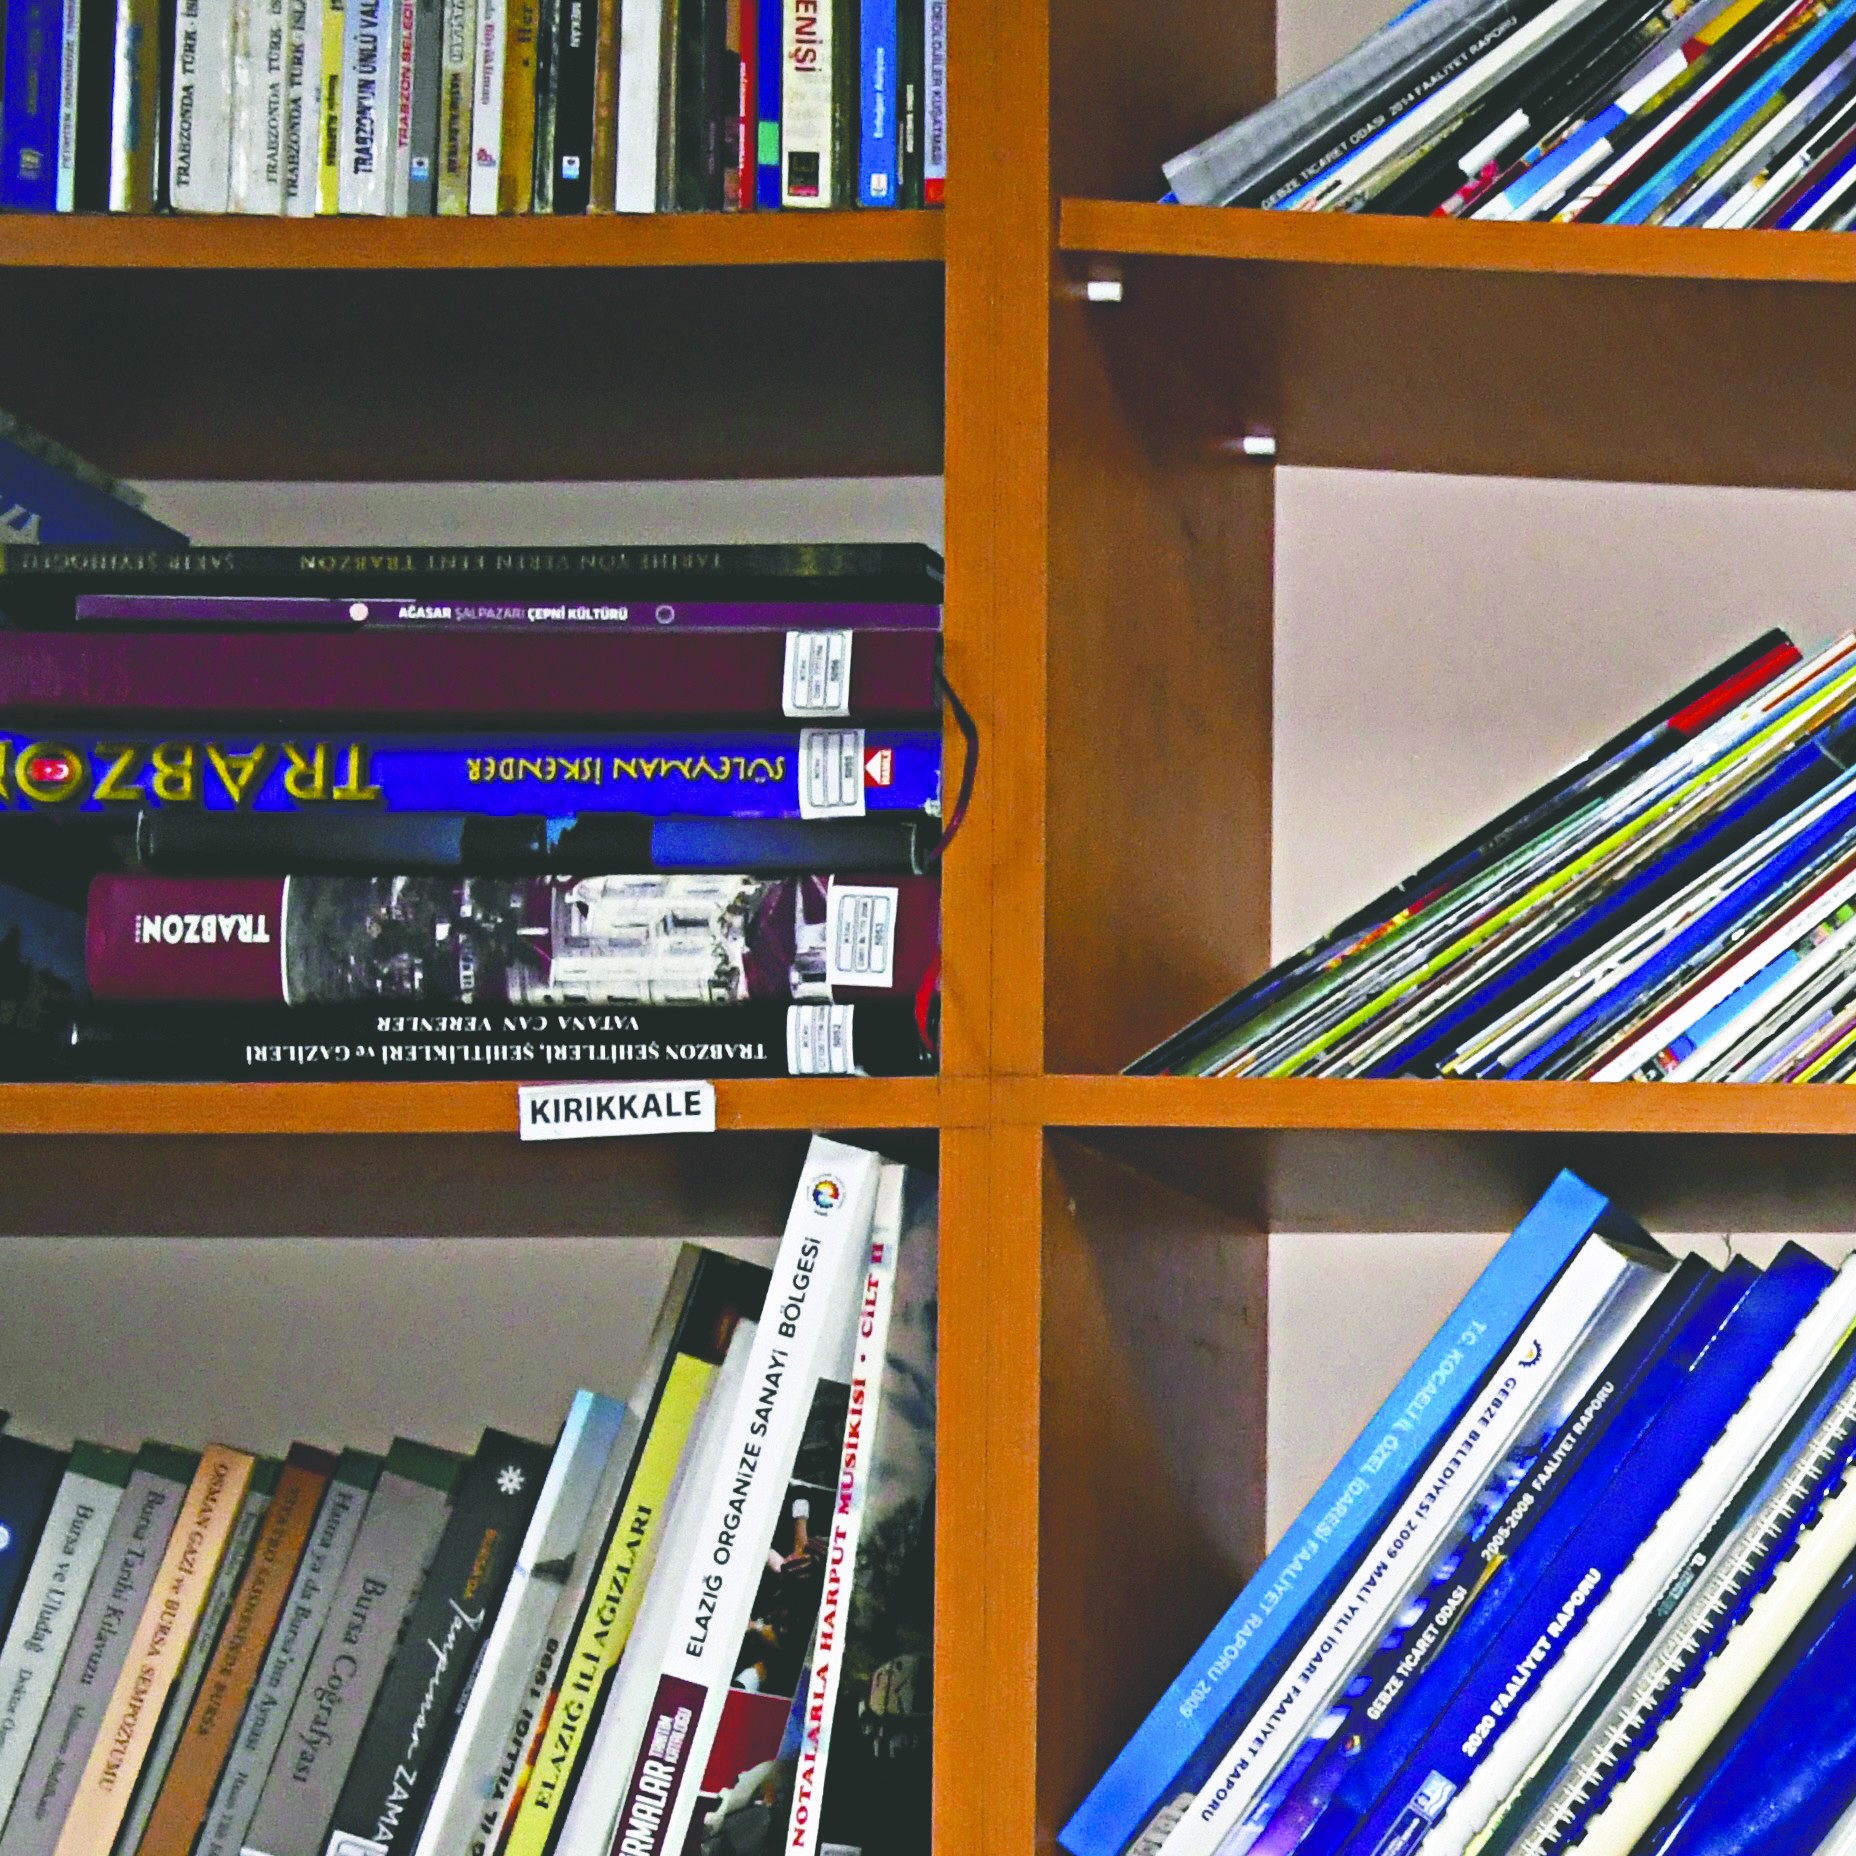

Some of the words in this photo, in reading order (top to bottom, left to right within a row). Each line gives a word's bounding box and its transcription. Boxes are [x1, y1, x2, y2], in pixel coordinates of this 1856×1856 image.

[466, 756, 601, 784] İSKENDER
[612, 756, 785, 784] SÜLEYMAN
[142, 914, 269, 943] TRABZON
[376, 1015, 490, 1030] VERENLER
[503, 1015, 547, 1030] CAN
[558, 1015, 638, 1030] VATANA
[530, 1090, 700, 1124] KIRIKKALE
[1473, 1373, 1520, 1430] GEBZE
[682, 1571, 725, 1658] ELAZIĞ
[708, 1440, 762, 1567] ORGANİZE
[745, 1347, 789, 1437] SANAYİ
[773, 1234, 821, 1339] BÖLGESİ
[1410, 1427, 1482, 1520] BELEDİYESİ
[1382, 1517, 1420, 1561] 2009
[1352, 1558, 1391, 1604] MALİ
[341, 1575, 388, 1649] Bursa
[1330, 1601, 1361, 1636] YILI
[529, 1698, 585, 1809] ELAZIĞ
[570, 1650, 602, 1693] İLİ
[587, 1503, 654, 1647] AĞIZLARI
[1295, 1633, 1339, 1686] İDARE
[1458, 1712, 1497, 1757] 2020
[1487, 1633, 1554, 1717] FAALİYET
[1544, 1566, 1603, 1639] RAPORU
[284, 1649, 361, 1786] Coğrafyası
[1243, 1684, 1304, 1760] FAALİYET
[1198, 1756, 1253, 1825] RAPORU
